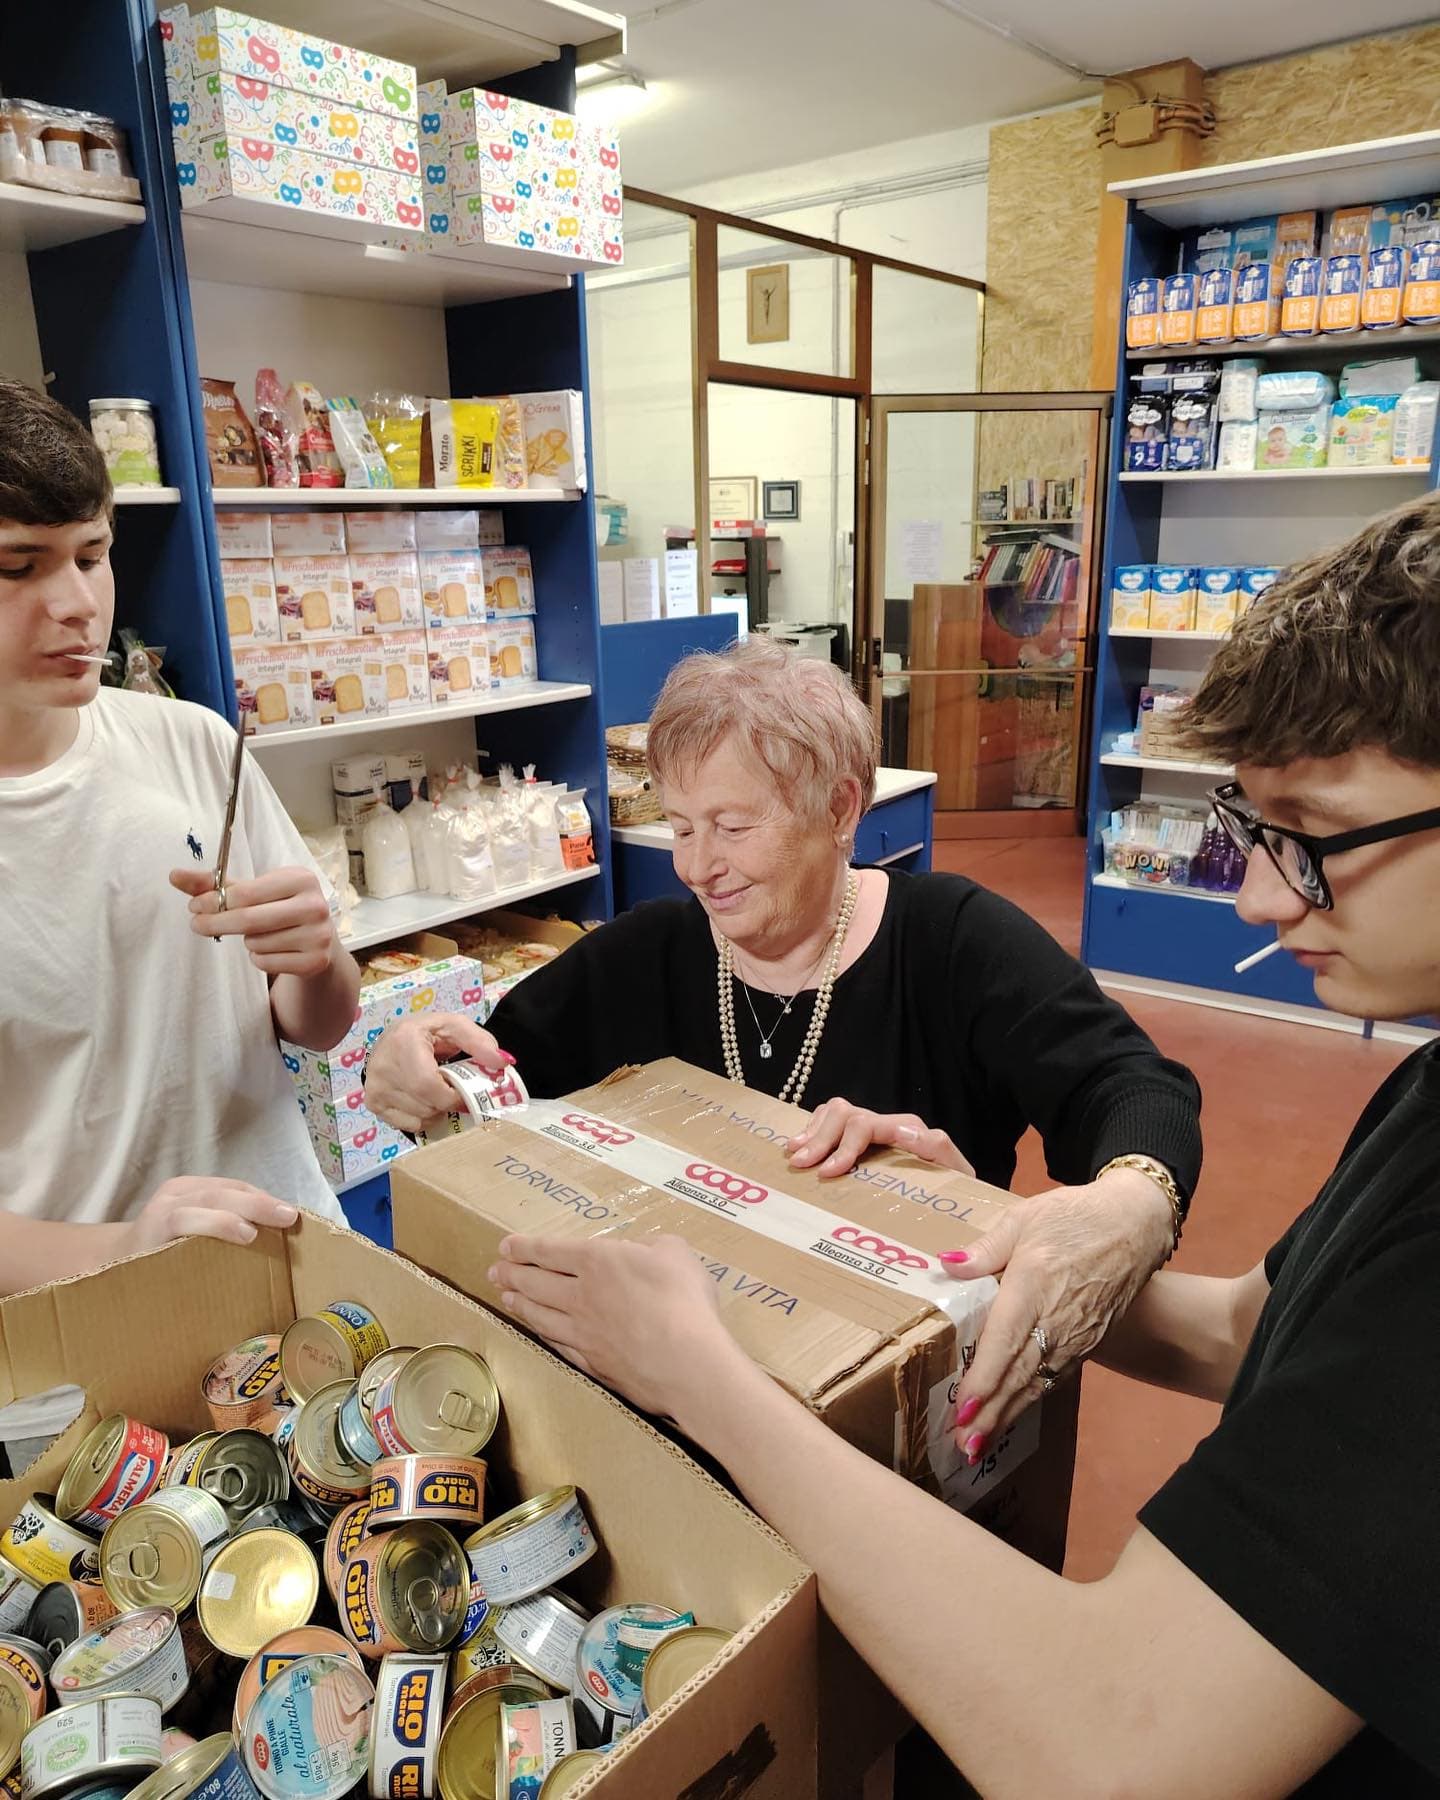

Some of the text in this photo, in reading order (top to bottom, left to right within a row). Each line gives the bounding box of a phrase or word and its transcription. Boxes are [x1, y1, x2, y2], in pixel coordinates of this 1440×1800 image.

[439, 434, 449, 472] Morato
[462, 435, 476, 477] SCRIKKI
[562, 1113, 635, 1145] coop
[666, 1179, 728, 1208] Alleanza 3.0
[685, 1163, 769, 1204] coop
[813, 1241, 886, 1276] Alleanza 3.0
[831, 1226, 929, 1270] coop
[733, 1275, 799, 1315] VITA
[110, 1453, 148, 1516] PALMERA
[370, 1487, 395, 1511] RI
[423, 1484, 475, 1506] RIO
[435, 1476, 469, 1487] mare
[347, 1564, 370, 1637] RIO
[360, 1574, 371, 1622] mare
[397, 1685, 410, 1728] mare
[404, 1675, 428, 1740] RIO
[266, 1717, 276, 1741] PINNE
[277, 1729, 290, 1756] GIALLE
[281, 1694, 306, 1758] naturale
[552, 1720, 565, 1758] TONN
[271, 1748, 284, 1775] TONNO
[293, 1761, 310, 1778] al
[392, 1775, 402, 1799] mar
